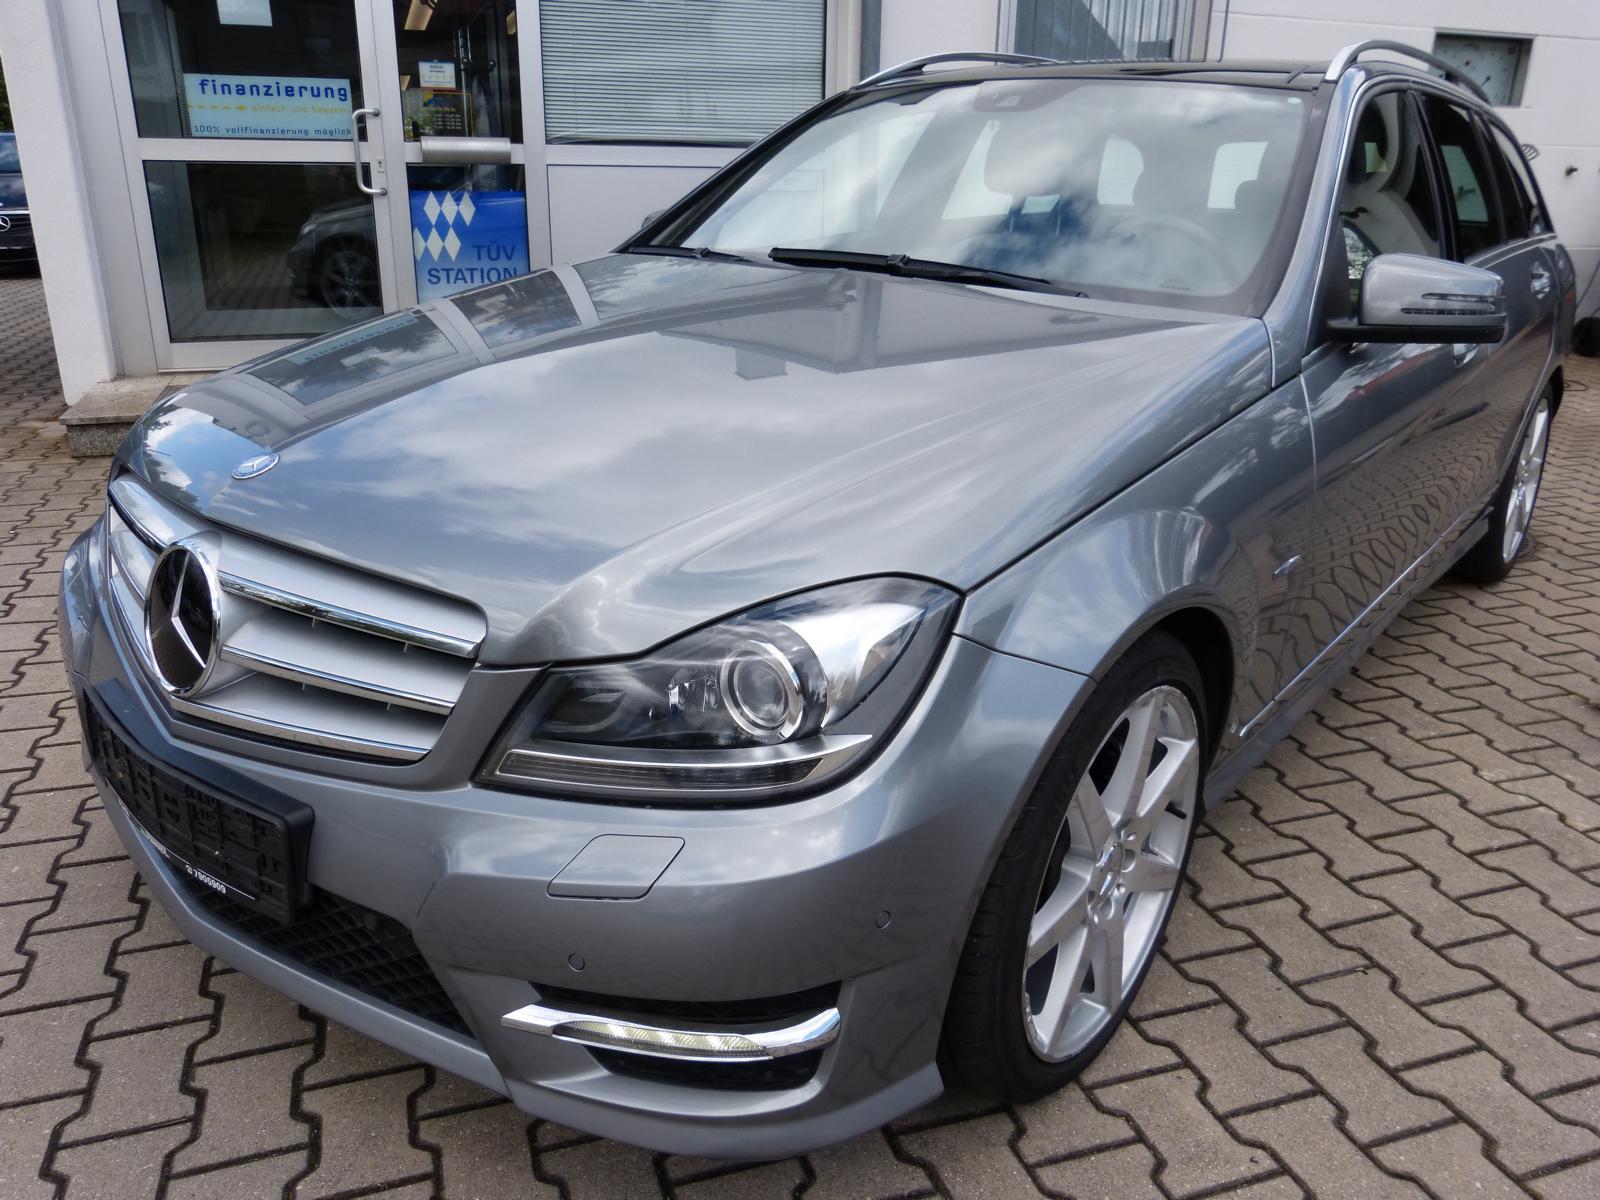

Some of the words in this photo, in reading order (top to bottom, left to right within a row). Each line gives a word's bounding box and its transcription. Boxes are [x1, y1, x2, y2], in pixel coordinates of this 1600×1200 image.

[199, 79, 348, 101] finanzierung
[194, 125, 220, 133] 100%
[225, 126, 309, 136] vollfinanzierung
[472, 240, 516, 261] TÜV
[427, 267, 517, 285] STATION
